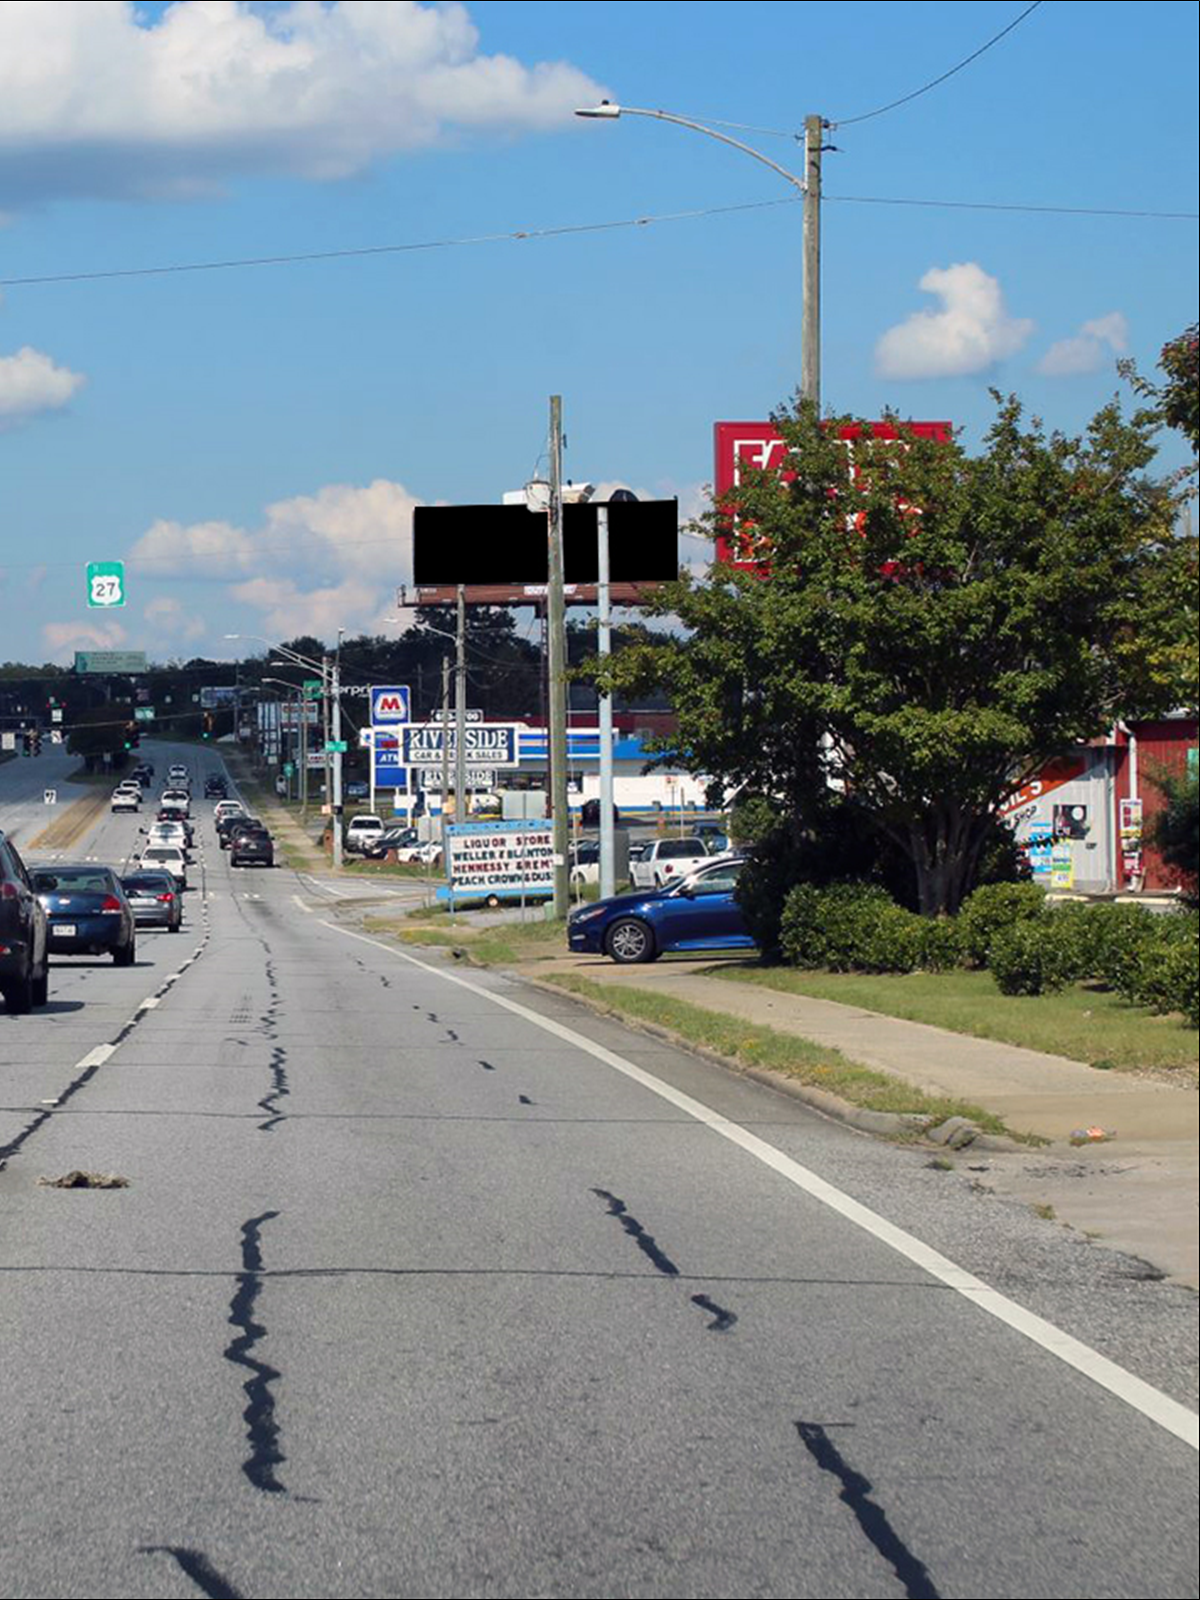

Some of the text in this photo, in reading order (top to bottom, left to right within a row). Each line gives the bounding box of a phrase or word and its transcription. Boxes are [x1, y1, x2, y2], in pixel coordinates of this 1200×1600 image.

[96, 582, 116, 597] 27
[409, 730, 508, 748] RIVESIDE
[414, 751, 432, 760] CAR
[475, 751, 503, 760] SALES
[464, 835, 550, 849] LIQUOR STORE
[453, 851, 495, 861] WELLER
[453, 862, 509, 873] HENNESSY
[451, 876, 485, 886] PEACH
[487, 874, 522, 884] CROWN
[531, 871, 554, 881] DUS
